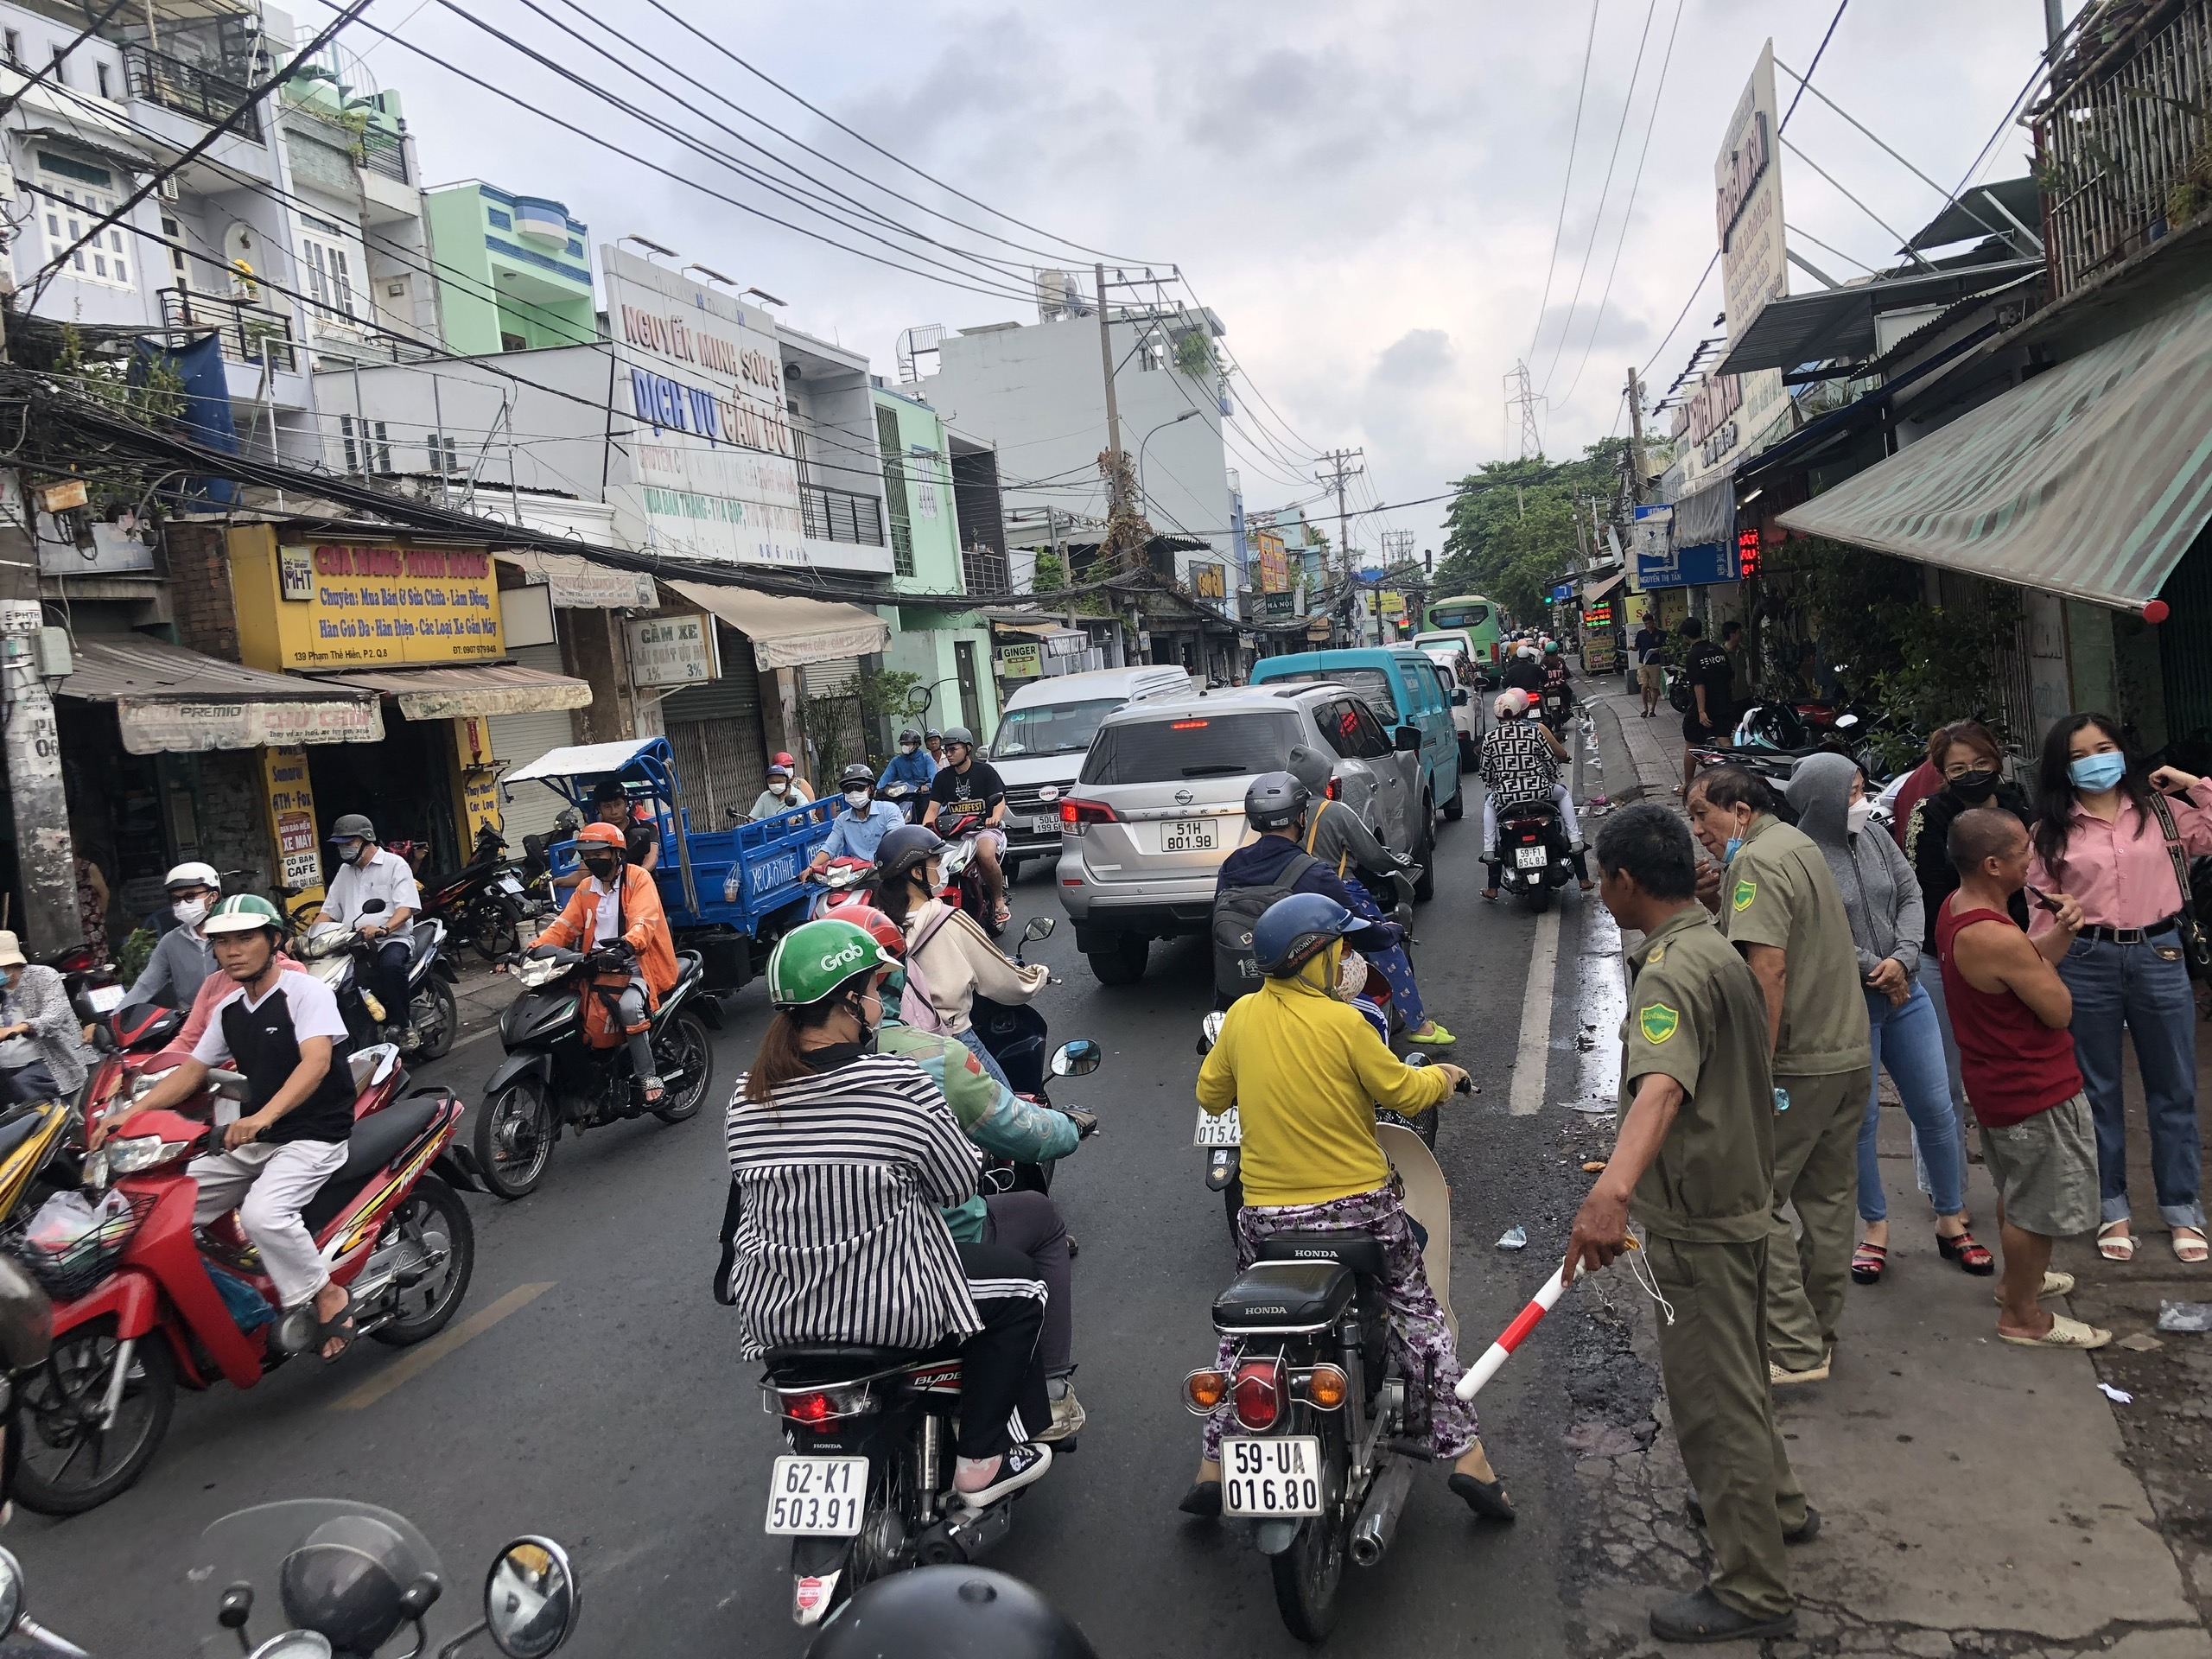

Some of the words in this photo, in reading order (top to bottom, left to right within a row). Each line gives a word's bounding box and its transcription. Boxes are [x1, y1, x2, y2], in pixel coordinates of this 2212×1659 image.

[622, 304, 695, 363] NGUYỄN
[696, 333, 739, 377] MINH
[740, 347, 769, 388] SƠN
[631, 369, 687, 436] DỊCH
[688, 385, 719, 448] VỤ
[720, 384, 761, 448] CẦM
[762, 396, 788, 454] ĐỒ
[643, 487, 663, 514] MUA
[1640, 572, 1661, 584] NGUYỄN
[320, 588, 359, 609] Chuyên:
[360, 588, 380, 606] Mua
[381, 588, 397, 606] Bán
[399, 588, 407, 606] &
[408, 586, 424, 606] Sửa
[425, 587, 446, 606] Chữa
[449, 588, 467, 607] Làm
[469, 586, 490, 609] Đồng
[319, 619, 339, 639] Hàn
[340, 618, 356, 638] Gió
[375, 619, 394, 638] Hàn
[395, 619, 415, 640] Điện
[419, 618, 435, 636] Các
[435, 618, 452, 639] Loại
[453, 618, 464, 634] Xe
[466, 614, 481, 635] Gắn
[482, 617, 497, 637] Máy
[641, 621, 673, 644] CẦM
[677, 624, 698, 642] XE
[294, 652, 306, 661] 139
[308, 651, 329, 663] Phạm
[331, 648, 344, 659] Thế
[346, 647, 362, 659] Hiển,
[1004, 645, 1036, 658] GINGER
[687, 663, 702, 677] 3%
[181, 706, 242, 717] PREMIO
[297, 790, 311, 809] Fox
[951, 801, 982, 814] LAZERFEST
[1142, 807, 1229, 817] TERRA
[1177, 823, 1201, 836] 51H
[283, 837, 294, 852] XE
[296, 830, 313, 849] MÁY
[1167, 836, 1211, 849] 801.98
[1521, 848, 1541, 857] 59-F1
[1518, 856, 1545, 868] 854.82
[287, 864, 316, 878] CAFE
[821, 942, 864, 971] Grab
[1198, 1126, 1243, 1143] 015.4
[1294, 1249, 1338, 1258] HONDA
[1245, 1306, 1287, 1315] HONDA
[914, 1371, 963, 1386] BLADE
[1235, 1443, 1306, 1474] 59-UA
[786, 1463, 850, 1494] 62-K1
[1228, 1478, 1316, 1510] 016.80
[773, 1497, 855, 1529] 503.91
